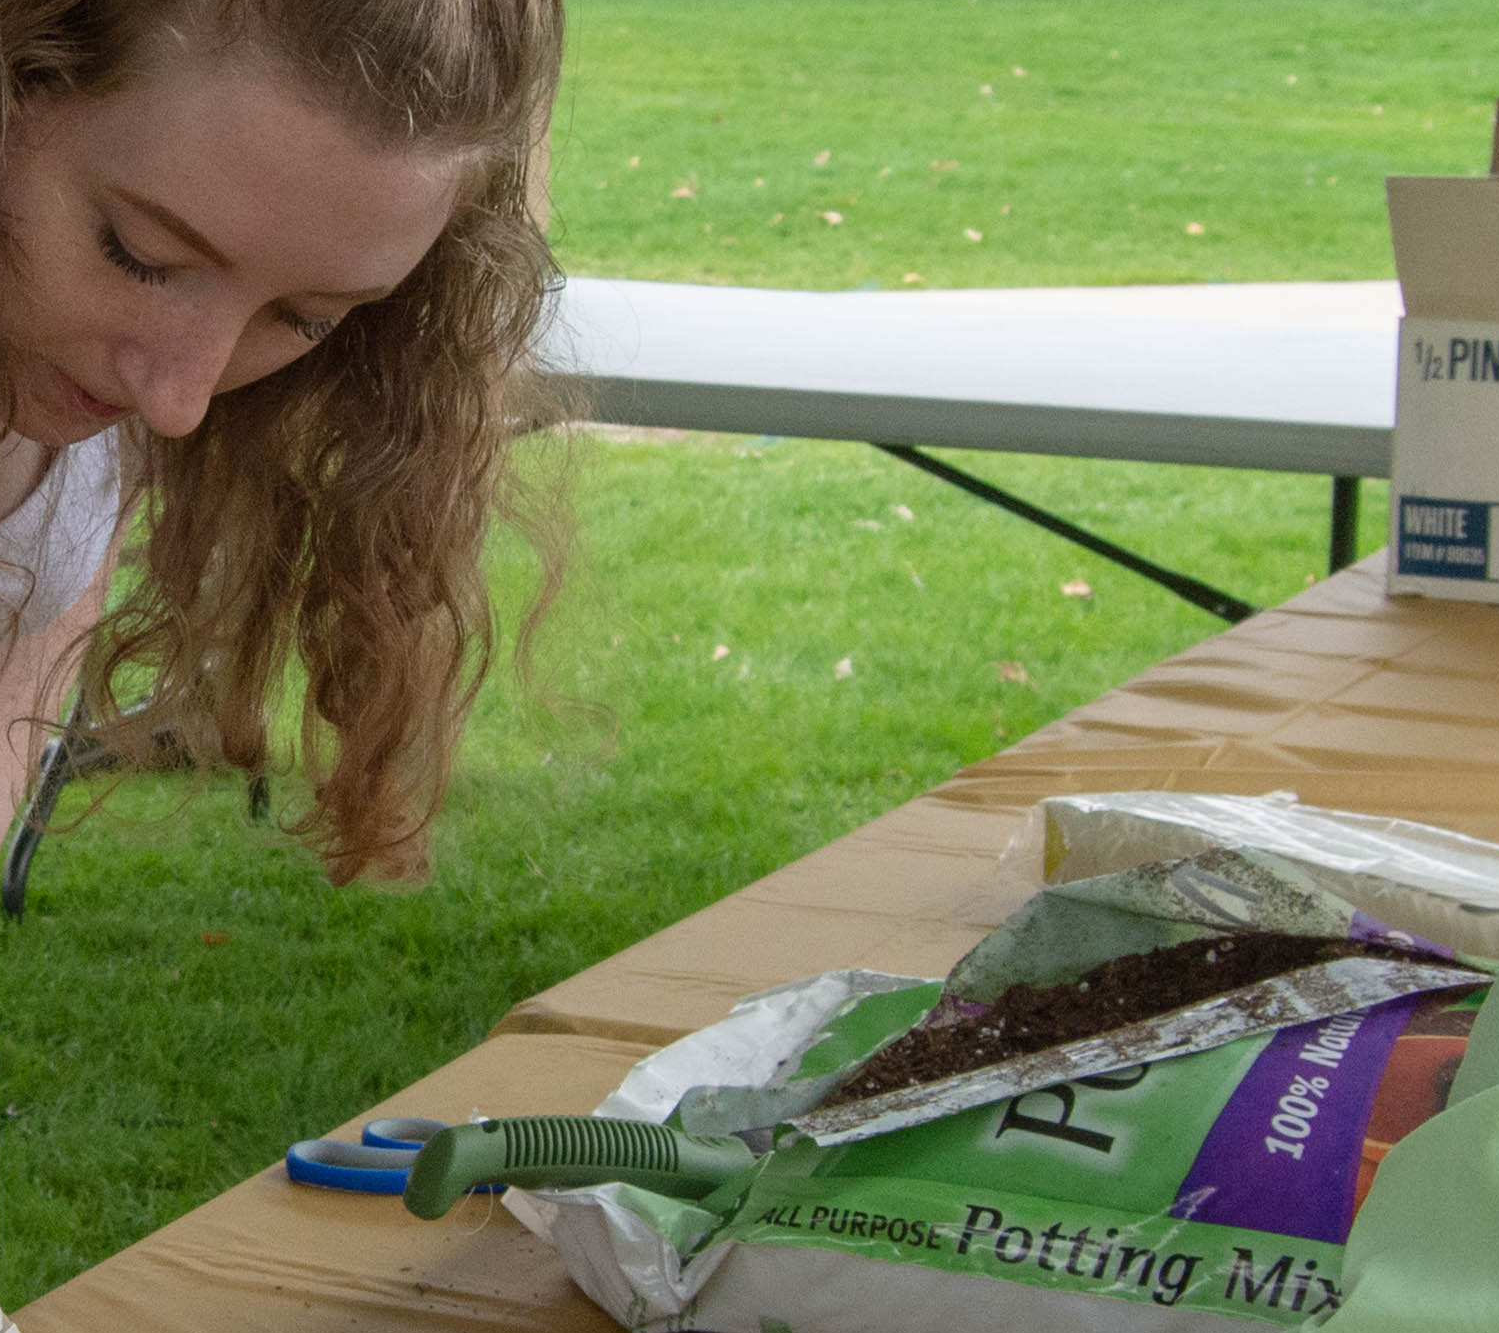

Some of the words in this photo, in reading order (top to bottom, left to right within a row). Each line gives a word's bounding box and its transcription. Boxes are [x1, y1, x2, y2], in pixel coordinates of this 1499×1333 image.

[1404, 504, 1469, 540] WHITE
[1264, 1074, 1330, 1160] 100%
[754, 1204, 802, 1228] ALL
[808, 1205, 947, 1250] PURPOSE
[955, 1202, 1203, 1306] Potting
[1225, 1246, 1343, 1315] Mix
